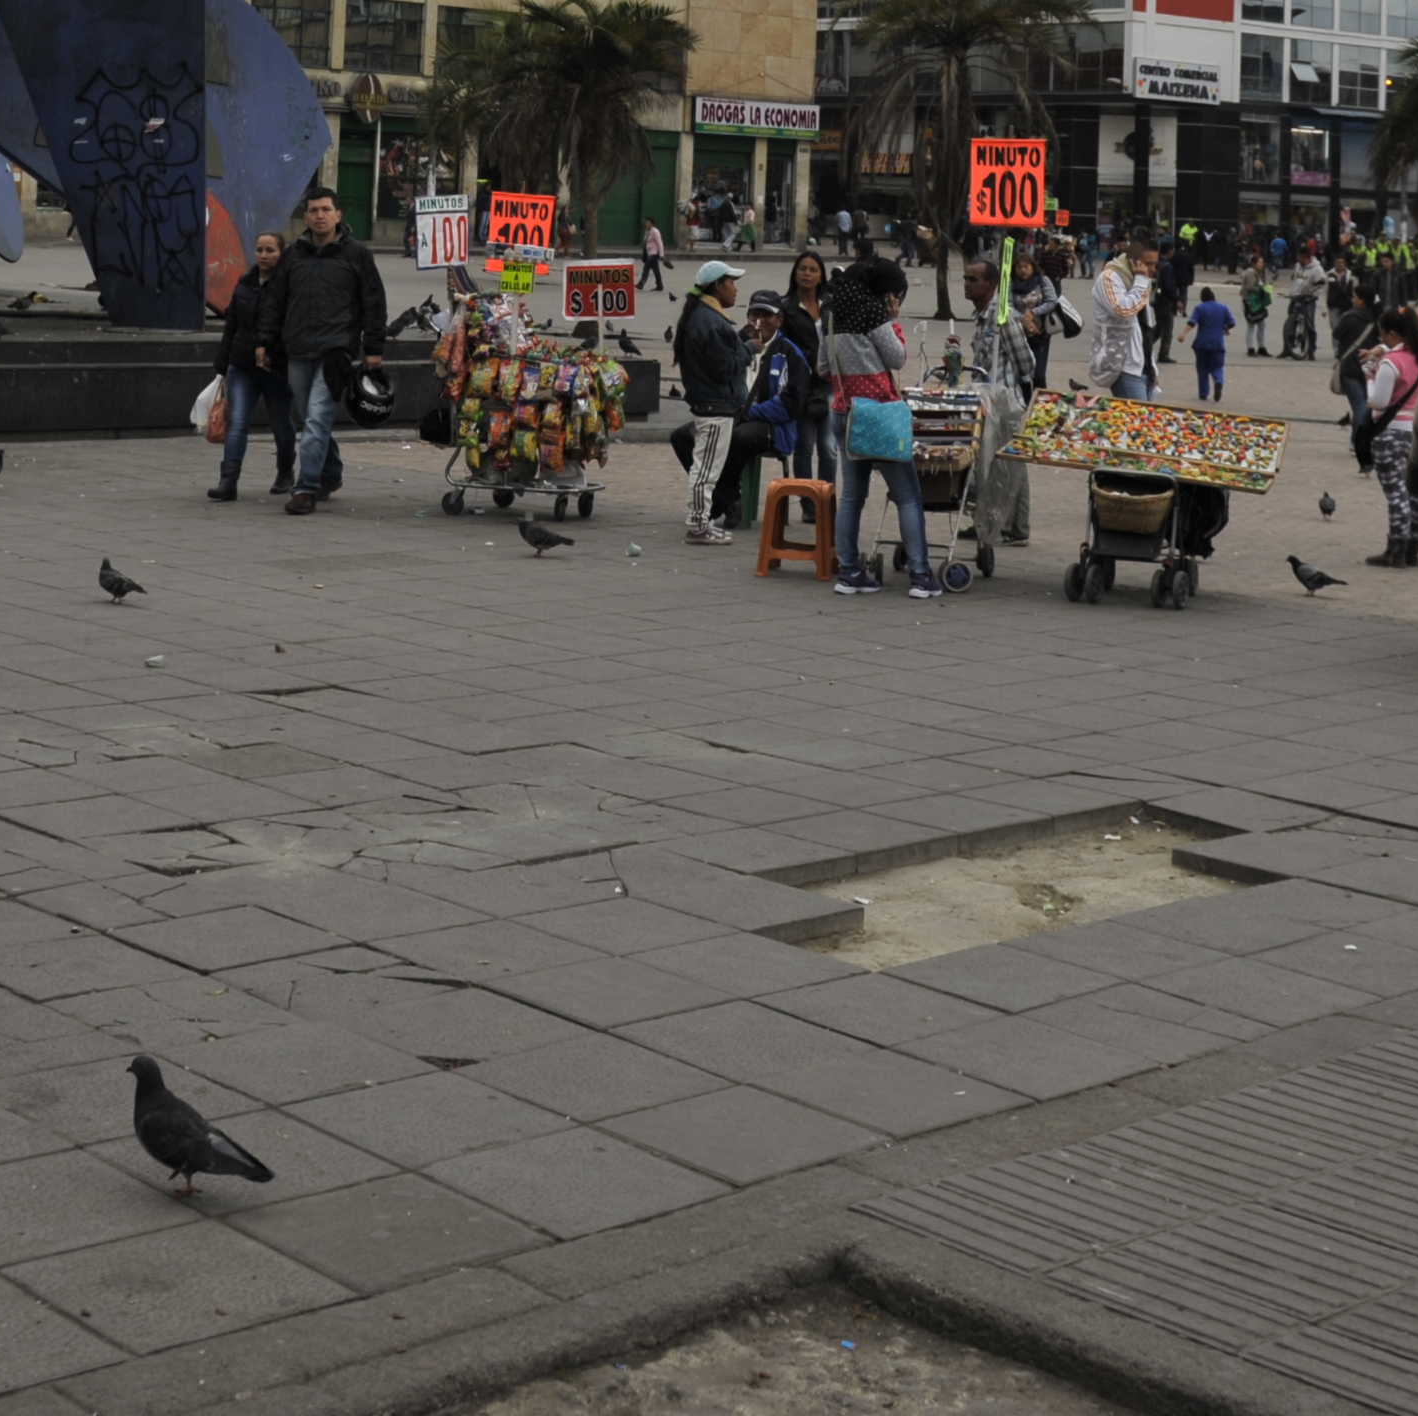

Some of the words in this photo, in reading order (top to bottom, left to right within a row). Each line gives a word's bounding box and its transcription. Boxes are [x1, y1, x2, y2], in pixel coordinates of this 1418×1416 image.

[1148, 81, 1209, 100] MAIZENA
[701, 102, 746, 125] DROGAS
[750, 106, 761, 126] LA
[764, 107, 817, 130] ECONOMIA
[976, 146, 1041, 168] MINUTO
[419, 197, 464, 211] MINUTOS
[976, 171, 1038, 219] $100
[493, 199, 549, 222] MINUTO
[421, 232, 429, 248] A
[431, 215, 468, 265] 100
[503, 264, 532, 274] MINUTOS
[569, 269, 630, 285] MINUTOS
[571, 290, 583, 314] $
[591, 290, 627, 312] 100
